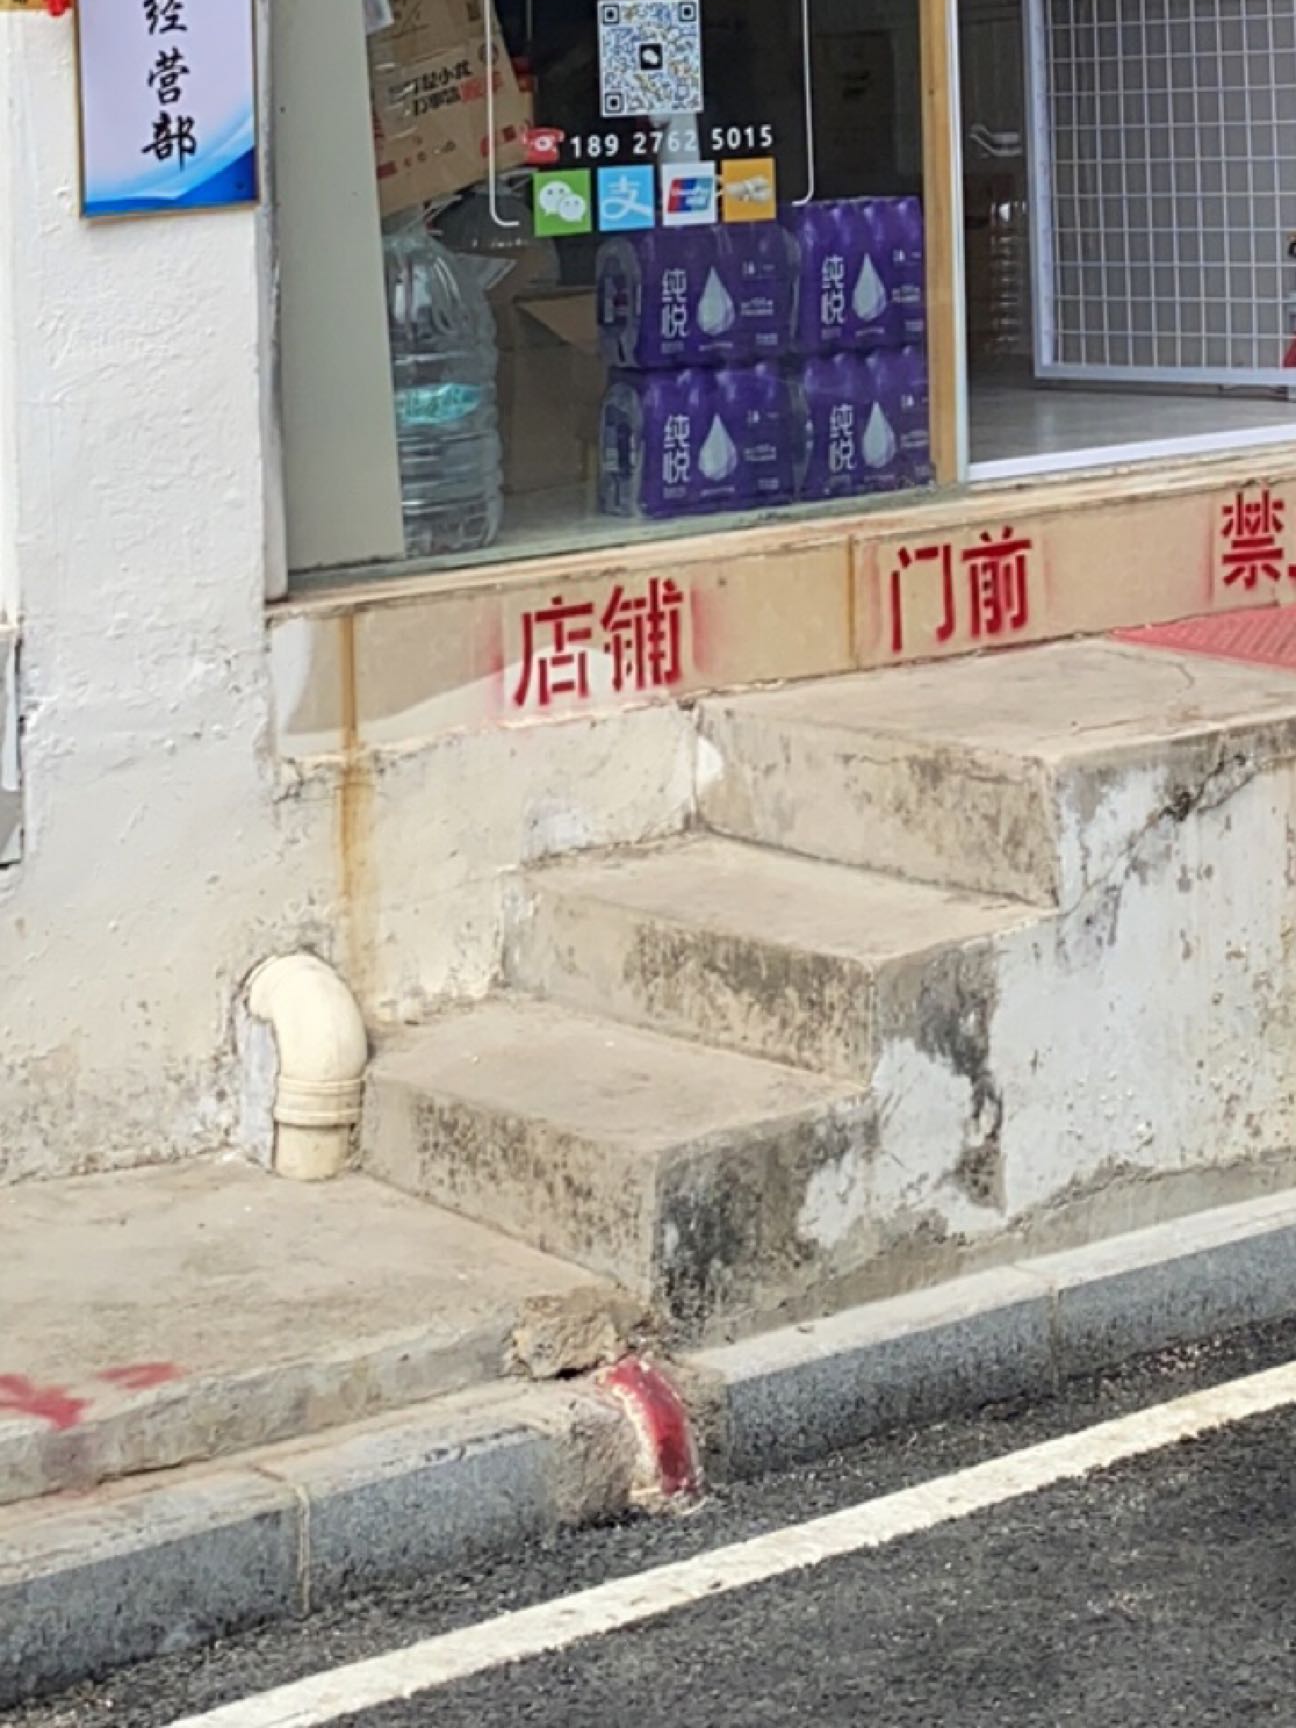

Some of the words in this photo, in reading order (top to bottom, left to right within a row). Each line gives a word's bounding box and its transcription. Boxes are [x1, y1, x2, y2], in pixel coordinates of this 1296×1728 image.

[570, 133, 620, 159] 189
[633, 130, 698, 155] 2762
[712, 124, 773, 151] 5015
[661, 267, 688, 339] 纯悦
[820, 254, 845, 325] 纯悦
[663, 413, 691, 484] 纯悦
[514, 577, 684, 707] 店铺
[892, 526, 1033, 654] 门前
